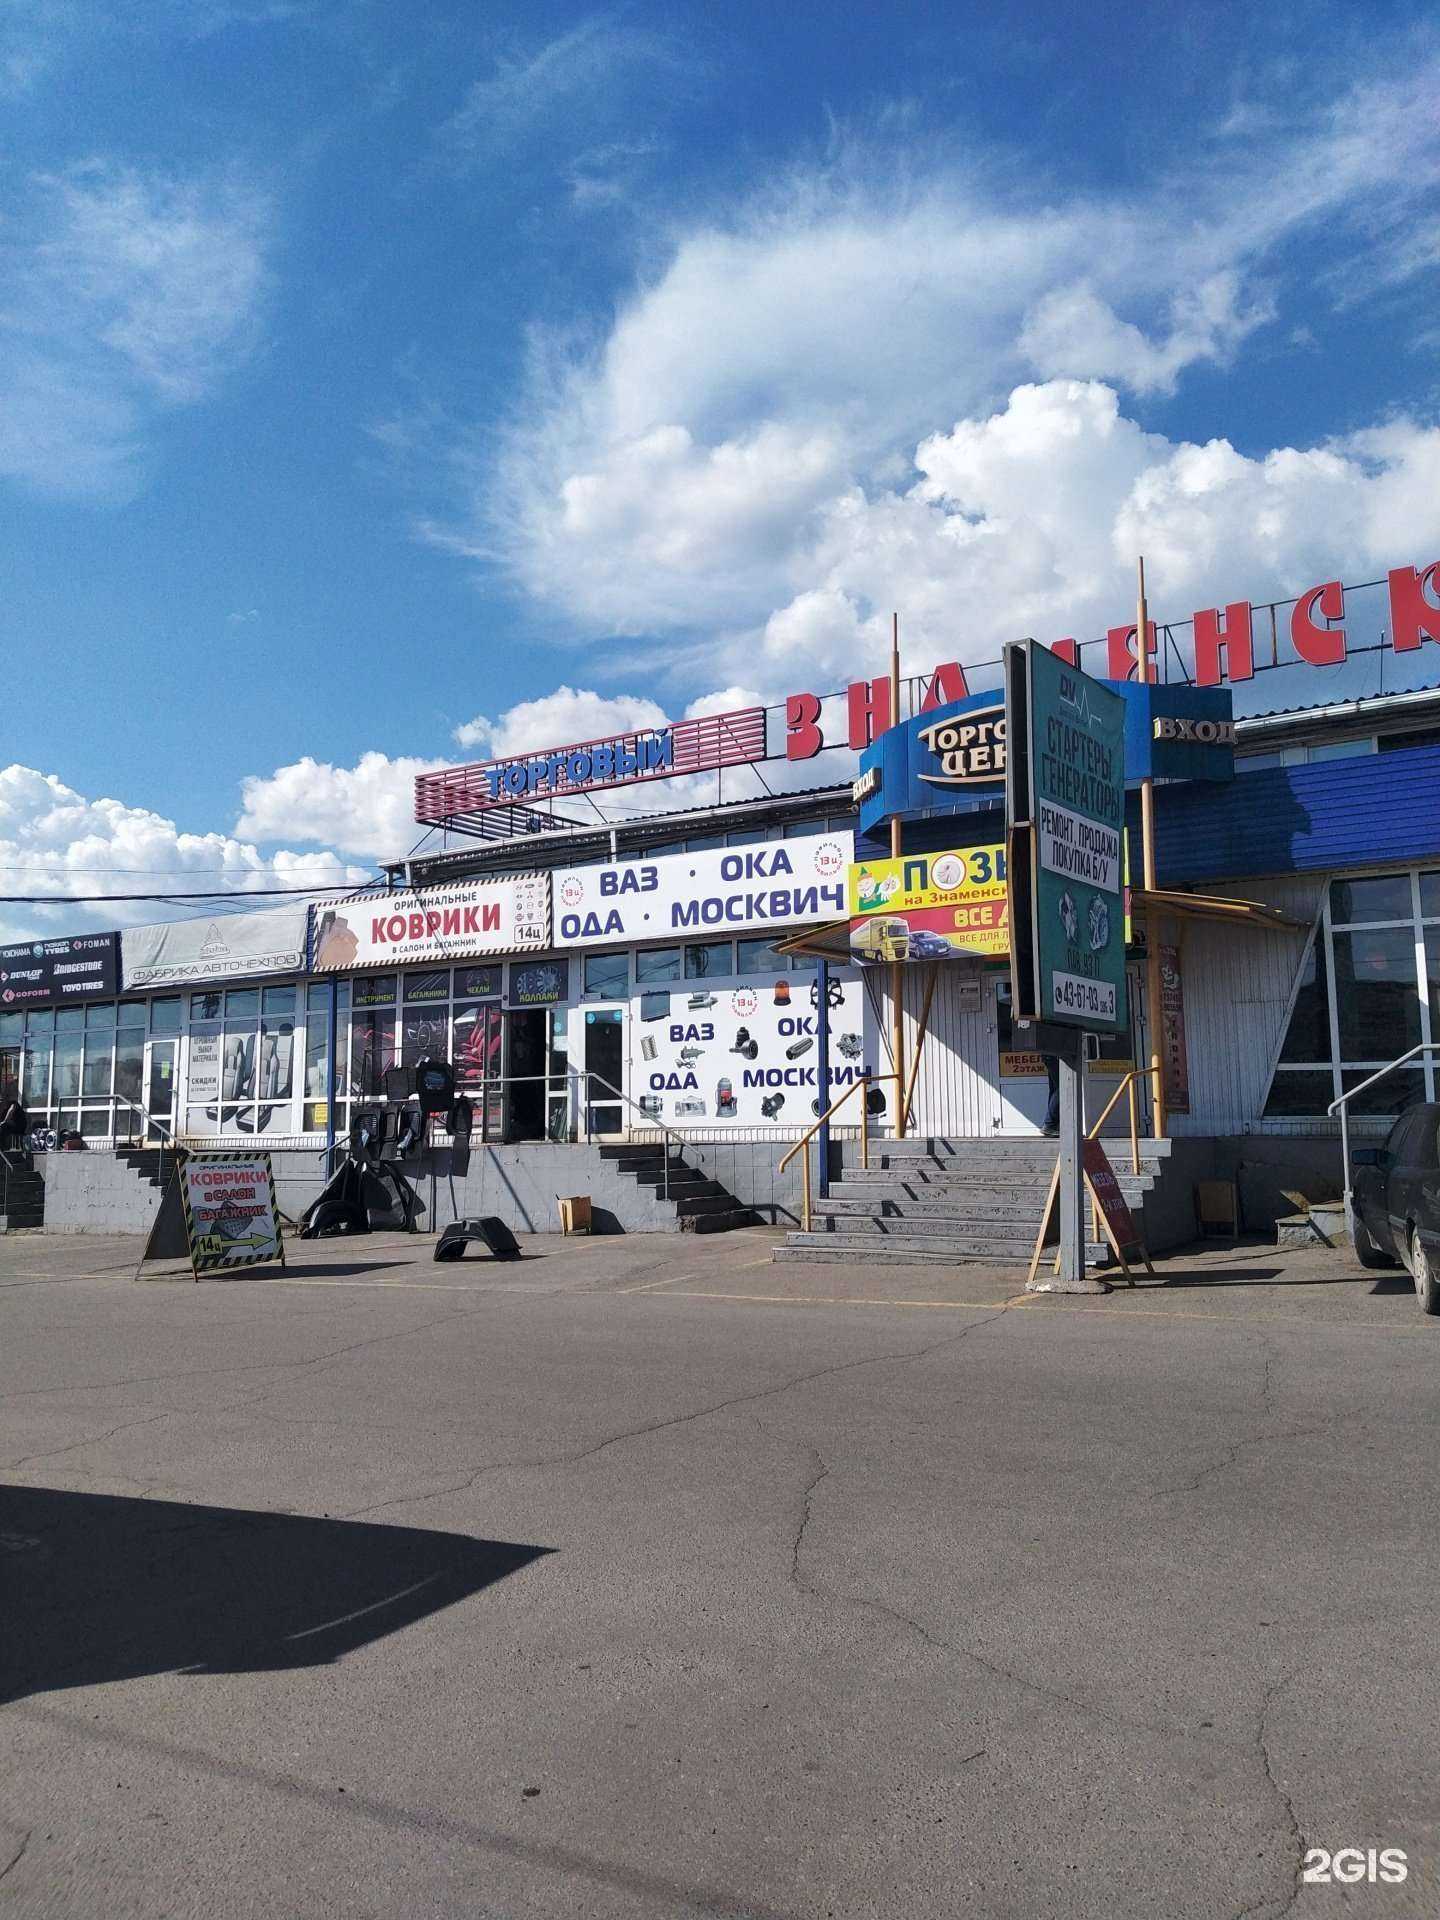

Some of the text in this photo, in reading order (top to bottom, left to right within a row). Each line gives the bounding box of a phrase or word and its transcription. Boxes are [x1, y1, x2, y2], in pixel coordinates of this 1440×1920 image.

[786, 560, 1440, 762] ЗНАЕНСК
[1153, 717, 1238, 744] ВХОД
[1047, 715, 1112, 783] СТАРТЕРЫ
[484, 727, 675, 798] ТОРГОВЫЙ
[852, 768, 878, 801] ВХОД
[1042, 752, 1121, 819] ГЕНЕРАТОРЫ
[1079, 823, 1118, 861] ПРОДАЖА
[1053, 840, 1109, 883] ПОКУПКА Б/У
[600, 849, 793, 897] ВАЗ ОКА
[394, 891, 478, 911] ОРИГИНАЛЬНЫЕ
[904, 895, 923, 906] на
[561, 883, 844, 938] ОДА МОСКВИЧ
[954, 906, 993, 928] ВСЕ
[371, 903, 501, 945] КОВРИКИ
[83, 938, 110, 949] FOMAN
[399, 944, 425, 953] САЛОН
[427, 943, 432, 951] И
[434, 938, 477, 950] БАГАЖНИК
[959, 934, 977, 943] ВСЕ
[979, 931, 1000, 942] ДЛЯ
[44, 947, 70, 955] TYRES
[10, 969, 43, 980] DUNLOP
[53, 960, 103, 975] BRIDGESTONE
[133, 954, 297, 980] ФАБРИКА АВТОЧЕХЛОВ
[62, 981, 104, 993] TOYO TIRES
[407, 989, 448, 999] БАГАЖНИКИ
[466, 984, 490, 993] ЧЕХЛЫ
[519, 992, 559, 1003] КОЛПАКИ
[1064, 981, 1099, 1012] 43-67-03
[1109, 990, 1114, 1014] 3
[669, 1023, 714, 1042] ВАЗ
[650, 1072, 699, 1091] ОДА
[190, 1171, 268, 1186] КОВРИКИ
[213, 1188, 256, 1202] САЛОН
[199, 1205, 268, 1221] БАГАЖНИК
